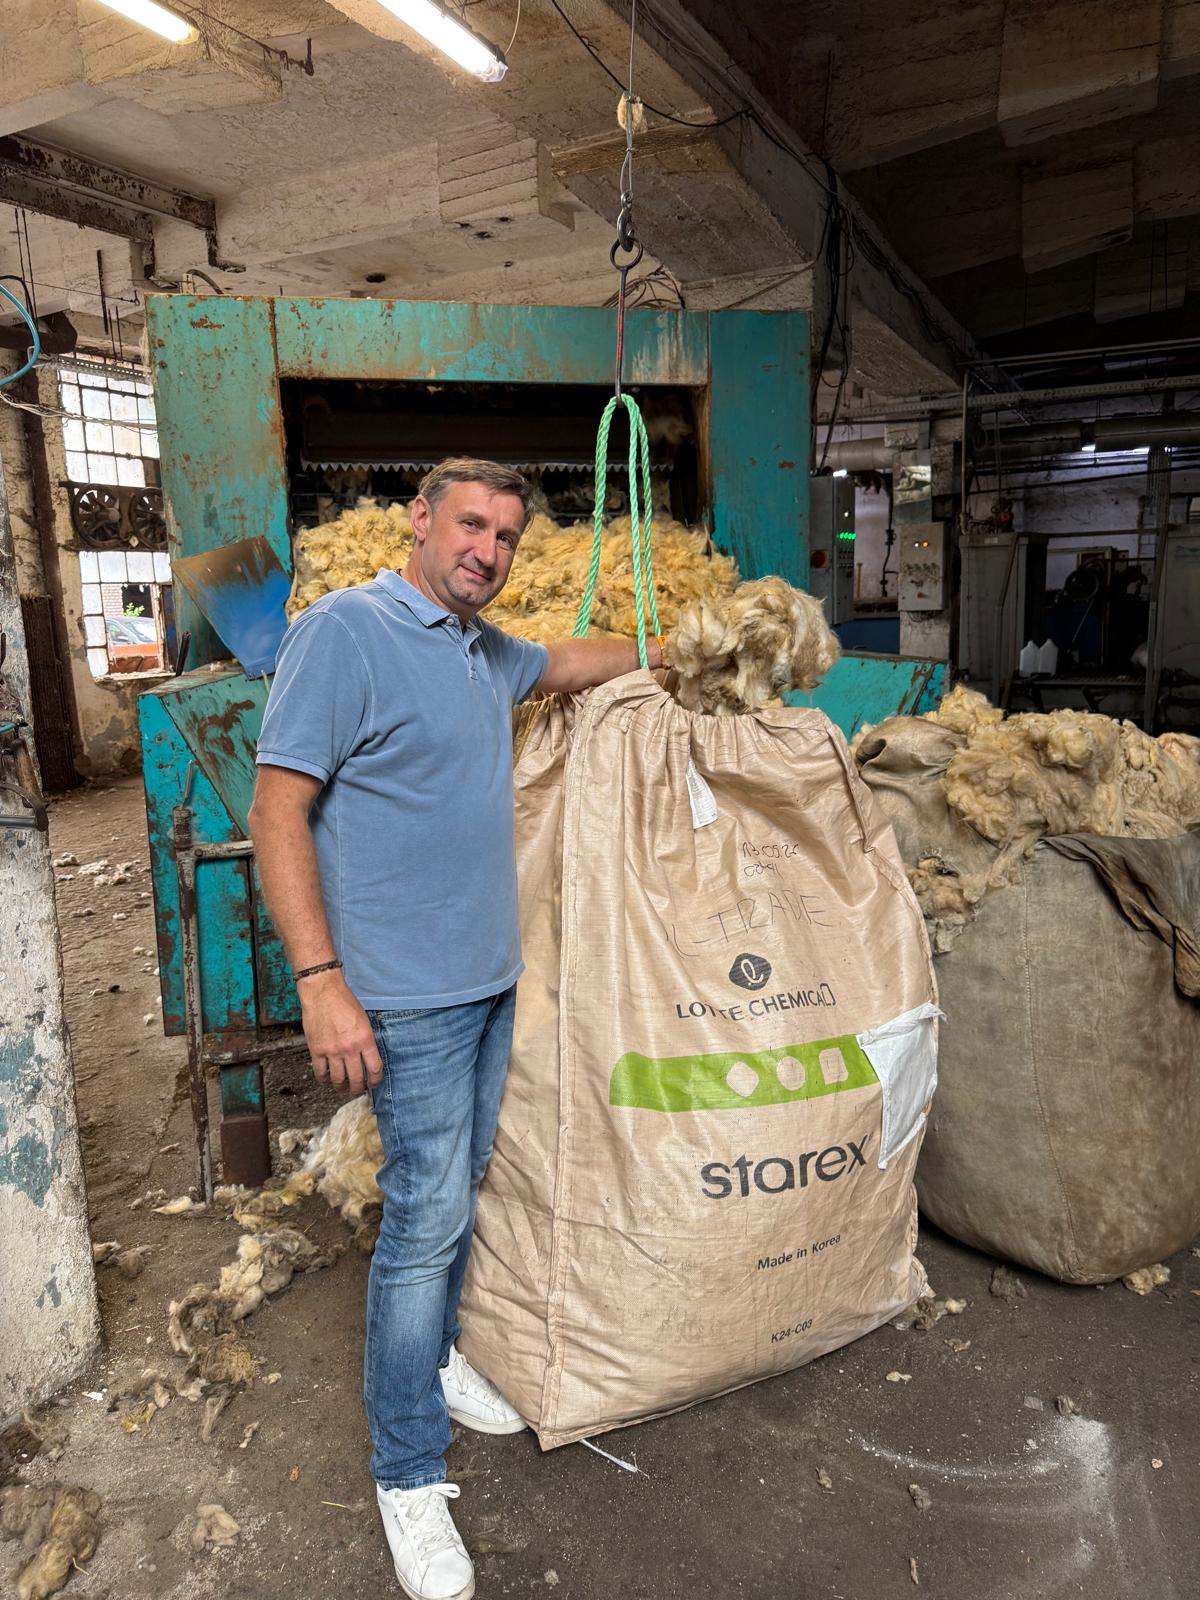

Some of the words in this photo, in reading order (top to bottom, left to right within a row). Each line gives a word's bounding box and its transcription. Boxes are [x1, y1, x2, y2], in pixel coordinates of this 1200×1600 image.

[676, 1001, 745, 1021] LOTTE
[700, 1134, 868, 1199] starex
[757, 1252, 793, 1270] Made
[796, 1248, 808, 1259] in
[812, 1234, 841, 1254] Korea
[771, 1319, 813, 1343] K24-C03
